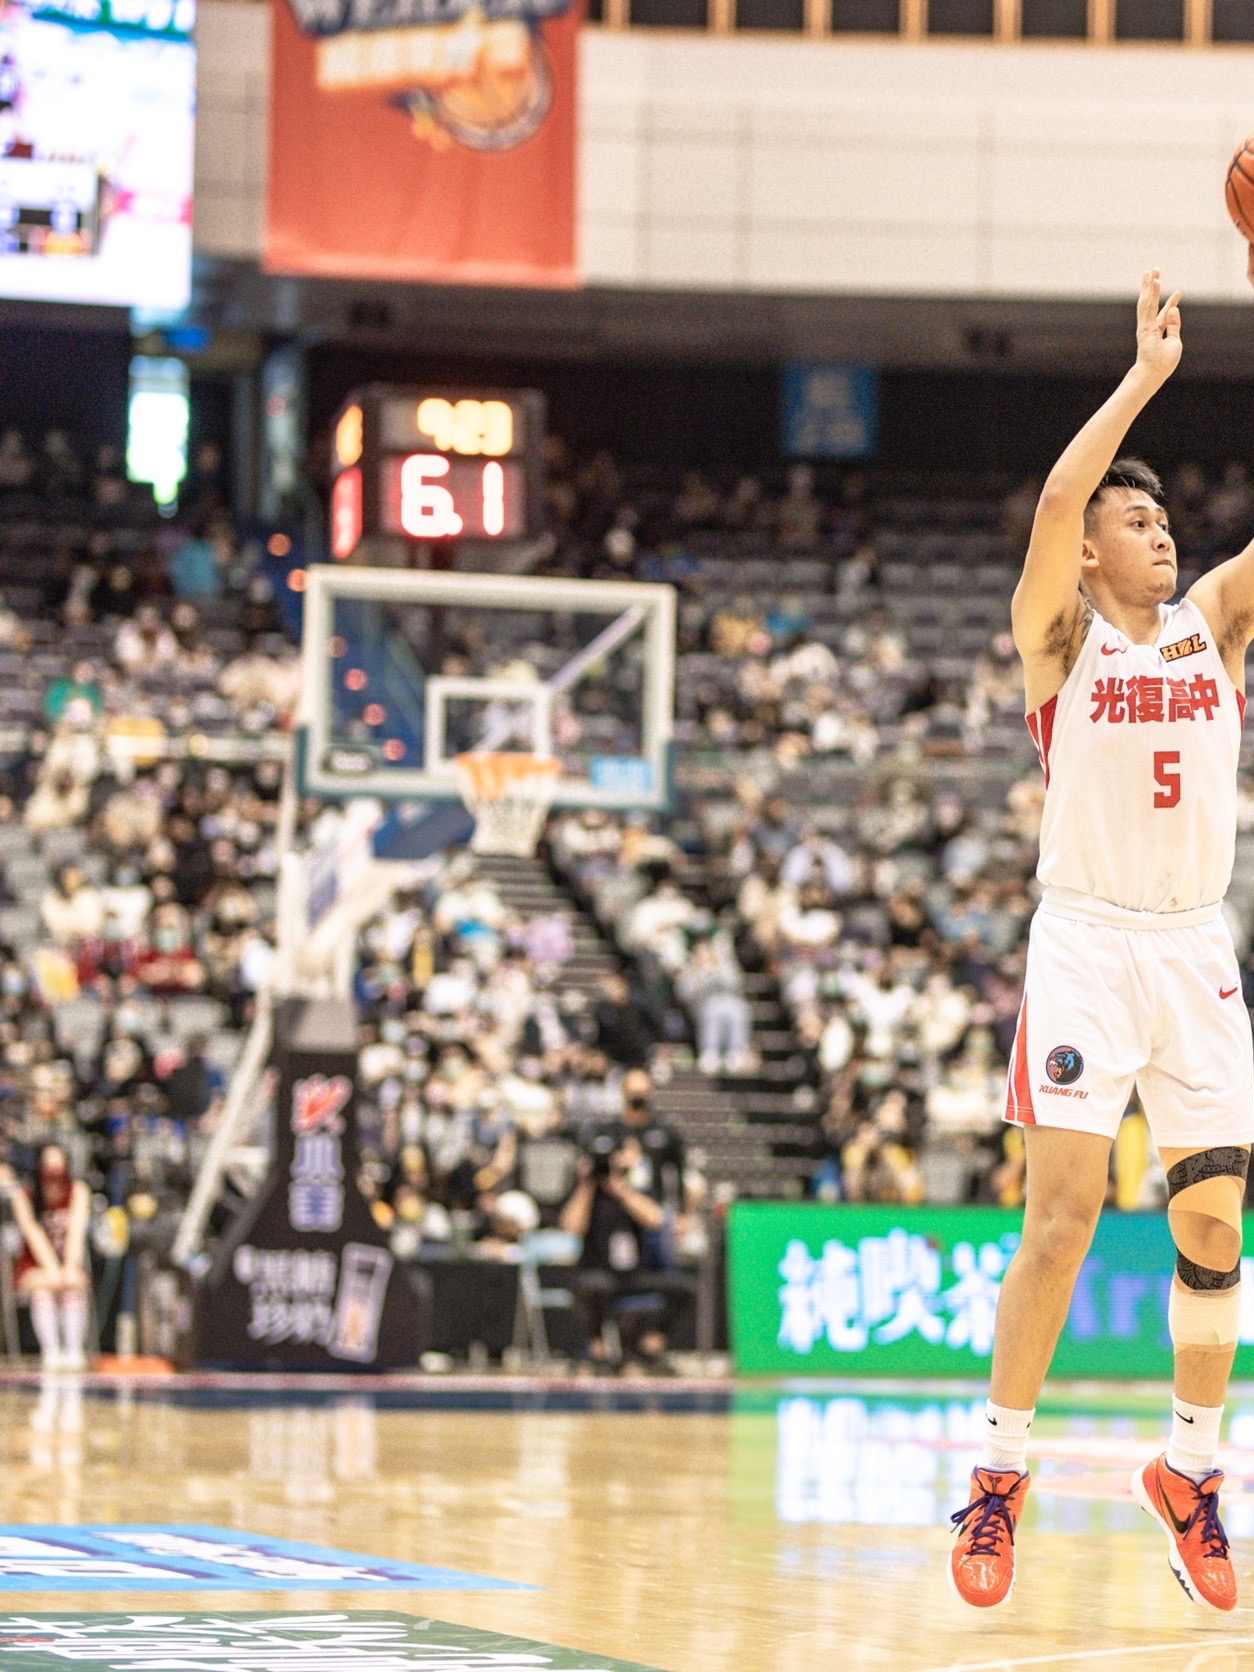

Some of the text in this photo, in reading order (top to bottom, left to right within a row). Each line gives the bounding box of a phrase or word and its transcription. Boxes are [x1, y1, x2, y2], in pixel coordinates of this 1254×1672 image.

[1159, 633, 1207, 663] HBL
[1090, 673, 1220, 723] 光復高中
[1153, 751, 1181, 808] 5
[1073, 1090, 1089, 1099] FU
